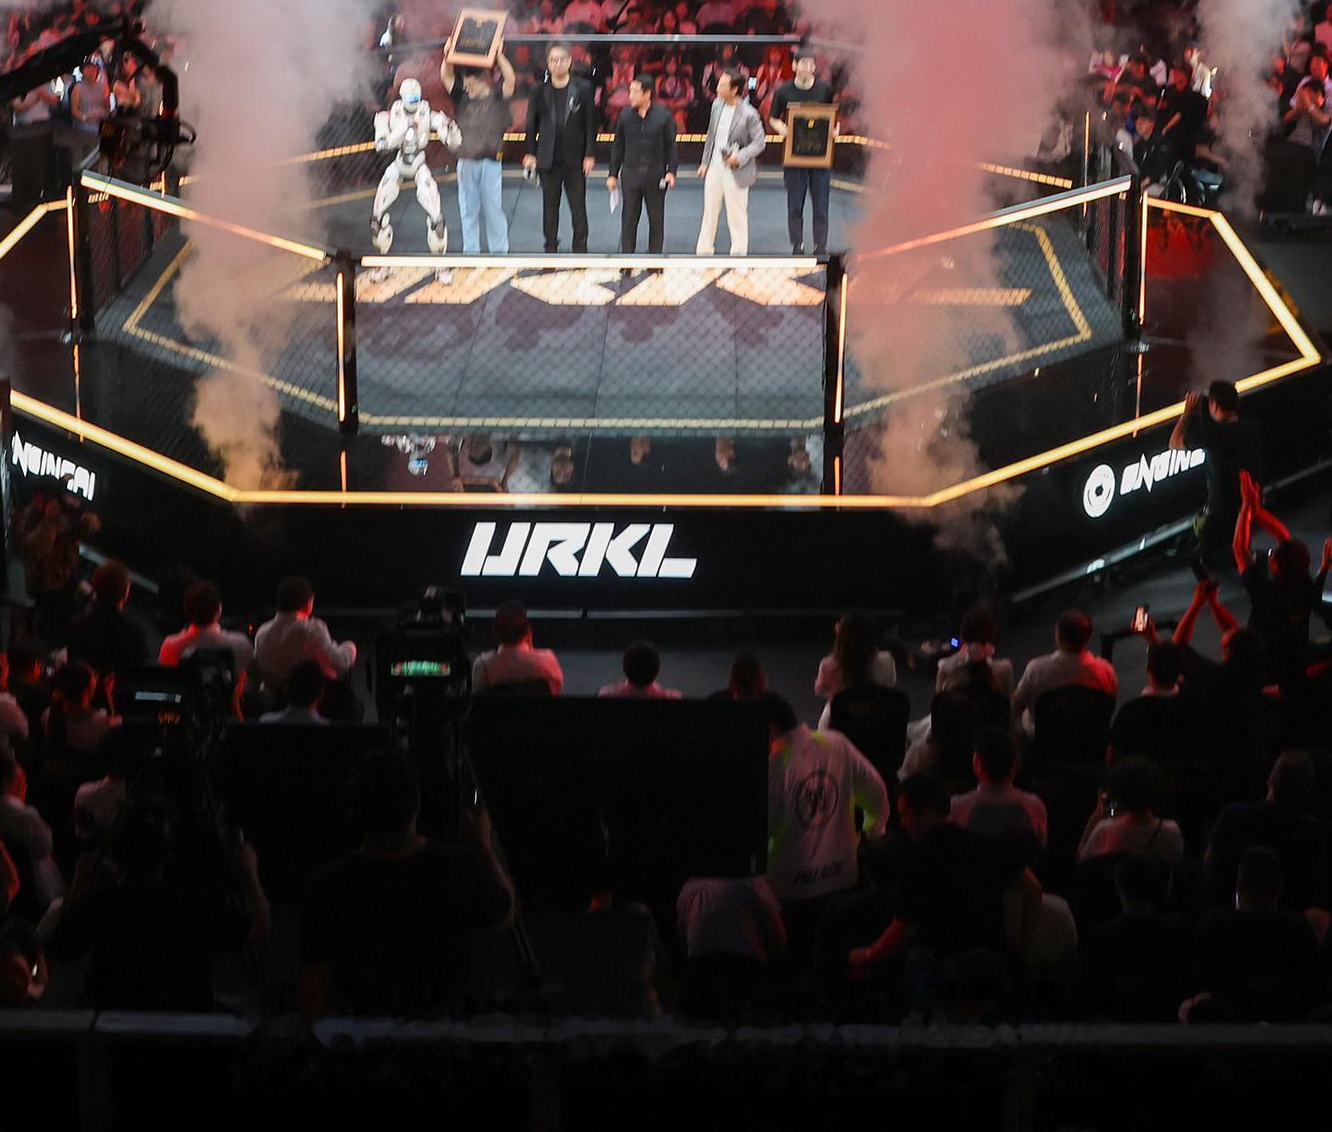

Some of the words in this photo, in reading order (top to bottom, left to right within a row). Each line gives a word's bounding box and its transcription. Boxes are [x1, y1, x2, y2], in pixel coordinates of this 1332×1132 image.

[12, 430, 96, 501] NGINEAI
[1120, 448, 1206, 496] ENGINE
[460, 521, 698, 578] URKL
